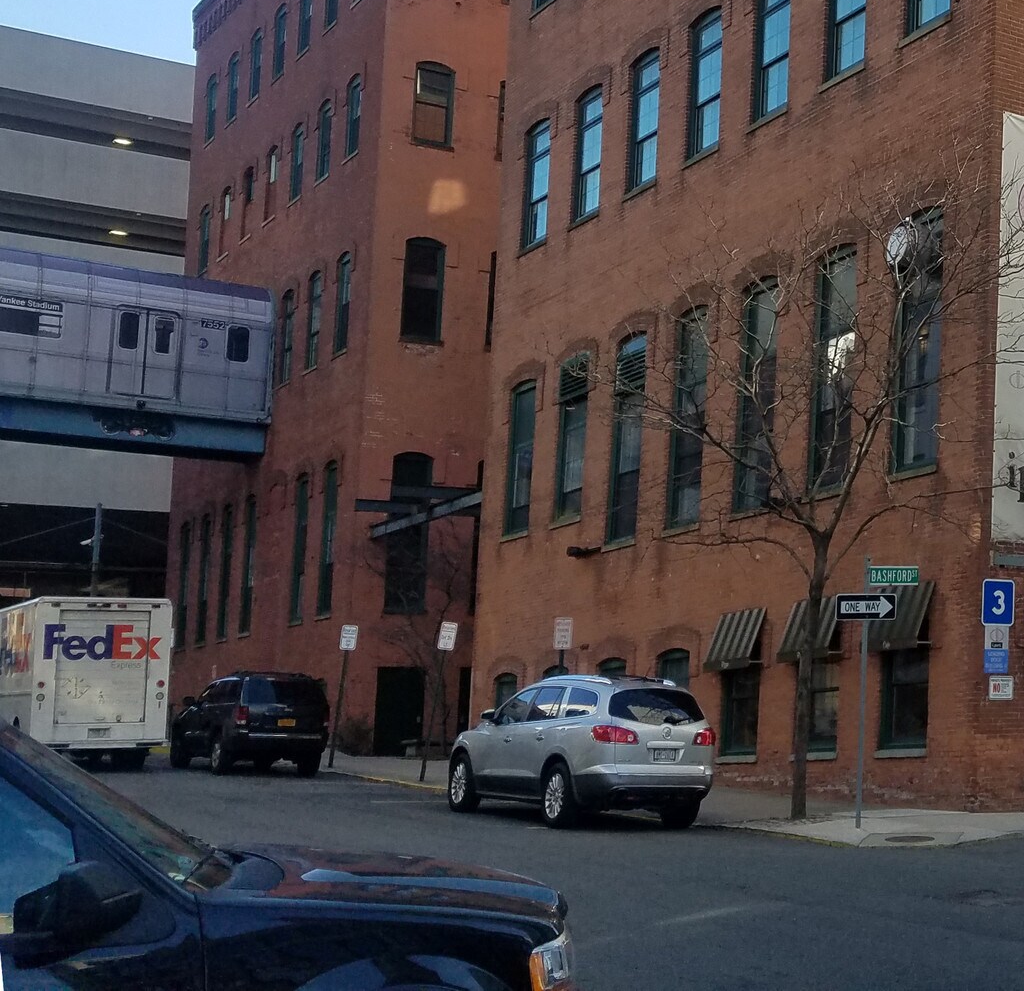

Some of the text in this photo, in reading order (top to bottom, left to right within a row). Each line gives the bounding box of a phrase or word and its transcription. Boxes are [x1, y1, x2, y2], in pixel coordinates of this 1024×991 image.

[27, 299, 60, 311] Stadium
[202, 319, 225, 330] 7552
[871, 569, 912, 582] BASHFORD
[844, 602, 880, 612] ONE WAY
[991, 589, 1006, 615] 3
[43, 624, 162, 660] FedEx
[111, 661, 142, 670] Express
[992, 683, 1001, 693] NO
